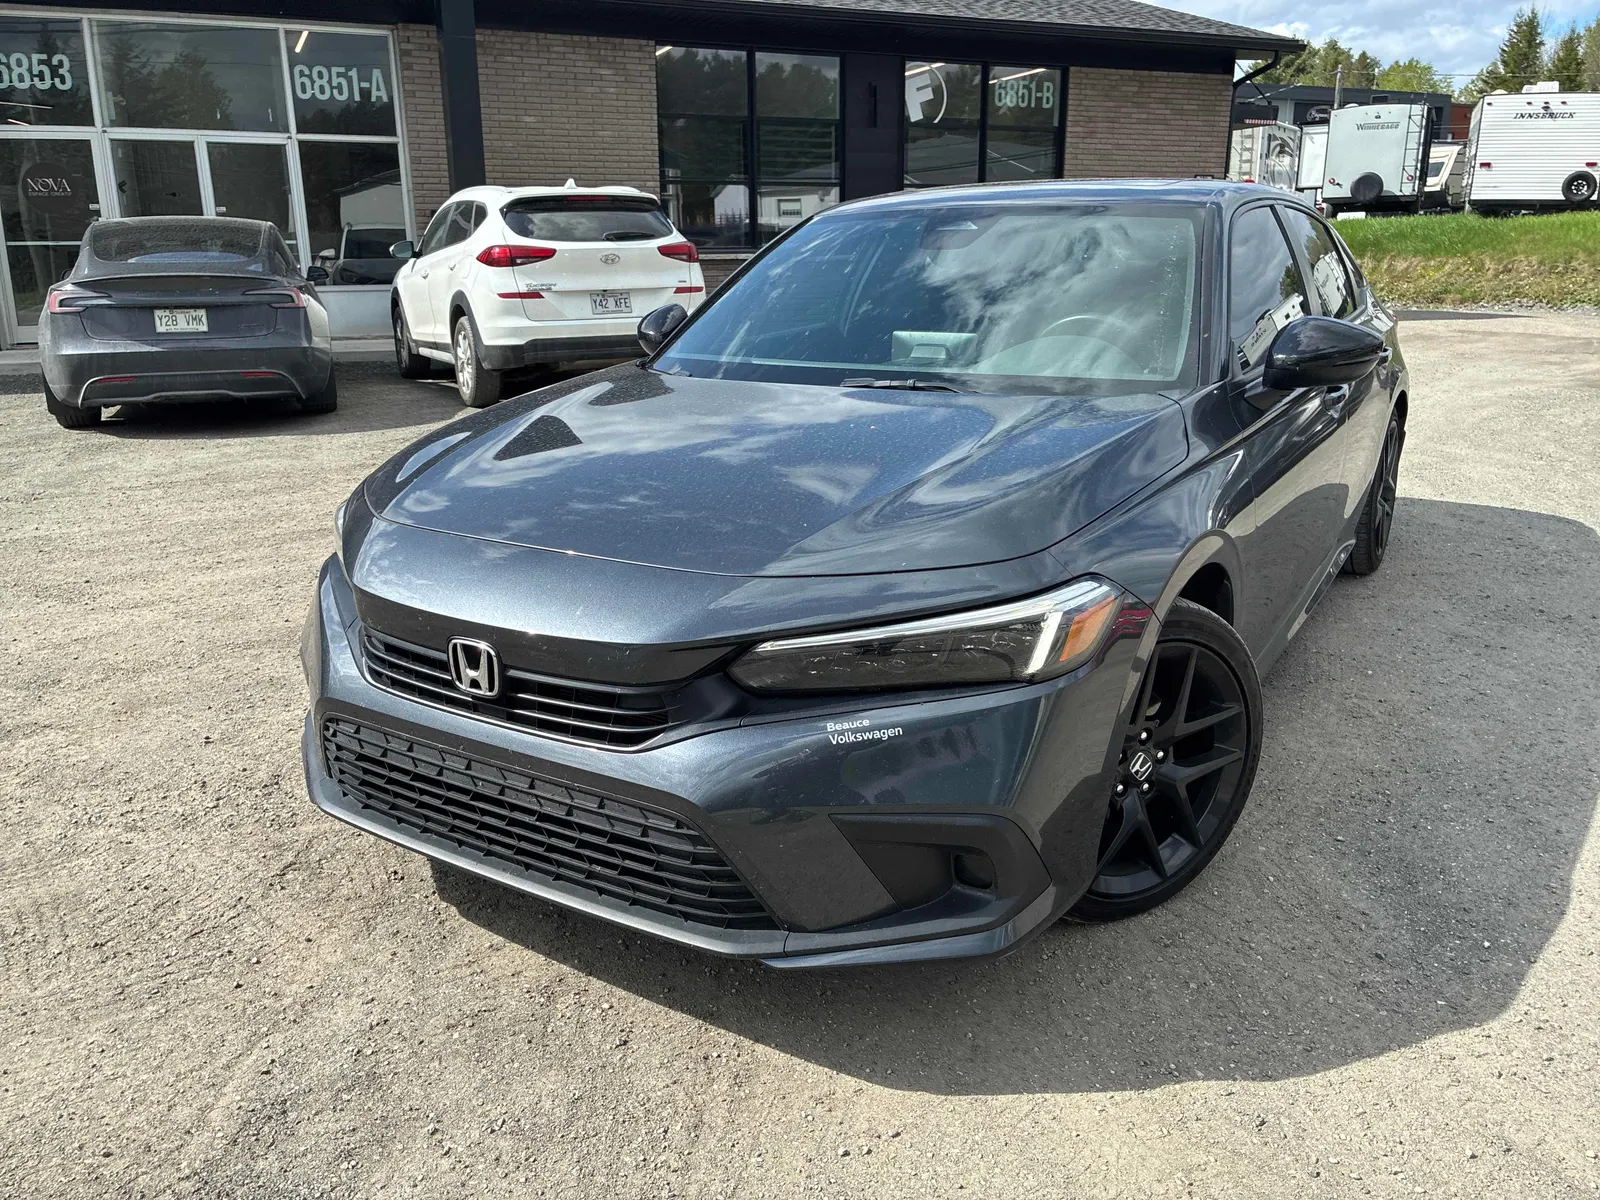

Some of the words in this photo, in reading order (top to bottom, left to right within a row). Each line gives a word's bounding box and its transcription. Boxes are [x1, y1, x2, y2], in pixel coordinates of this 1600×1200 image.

[293, 64, 389, 102] 6851-A
[994, 80, 1054, 108] 6851-B
[27, 178, 72, 192] NOVA
[592, 298, 609, 309] Y42
[613, 297, 630, 309] XFE
[157, 314, 178, 327] Y28
[184, 314, 205, 326] VMK
[826, 719, 870, 732] Beauce
[828, 727, 903, 745] Volkswagen
